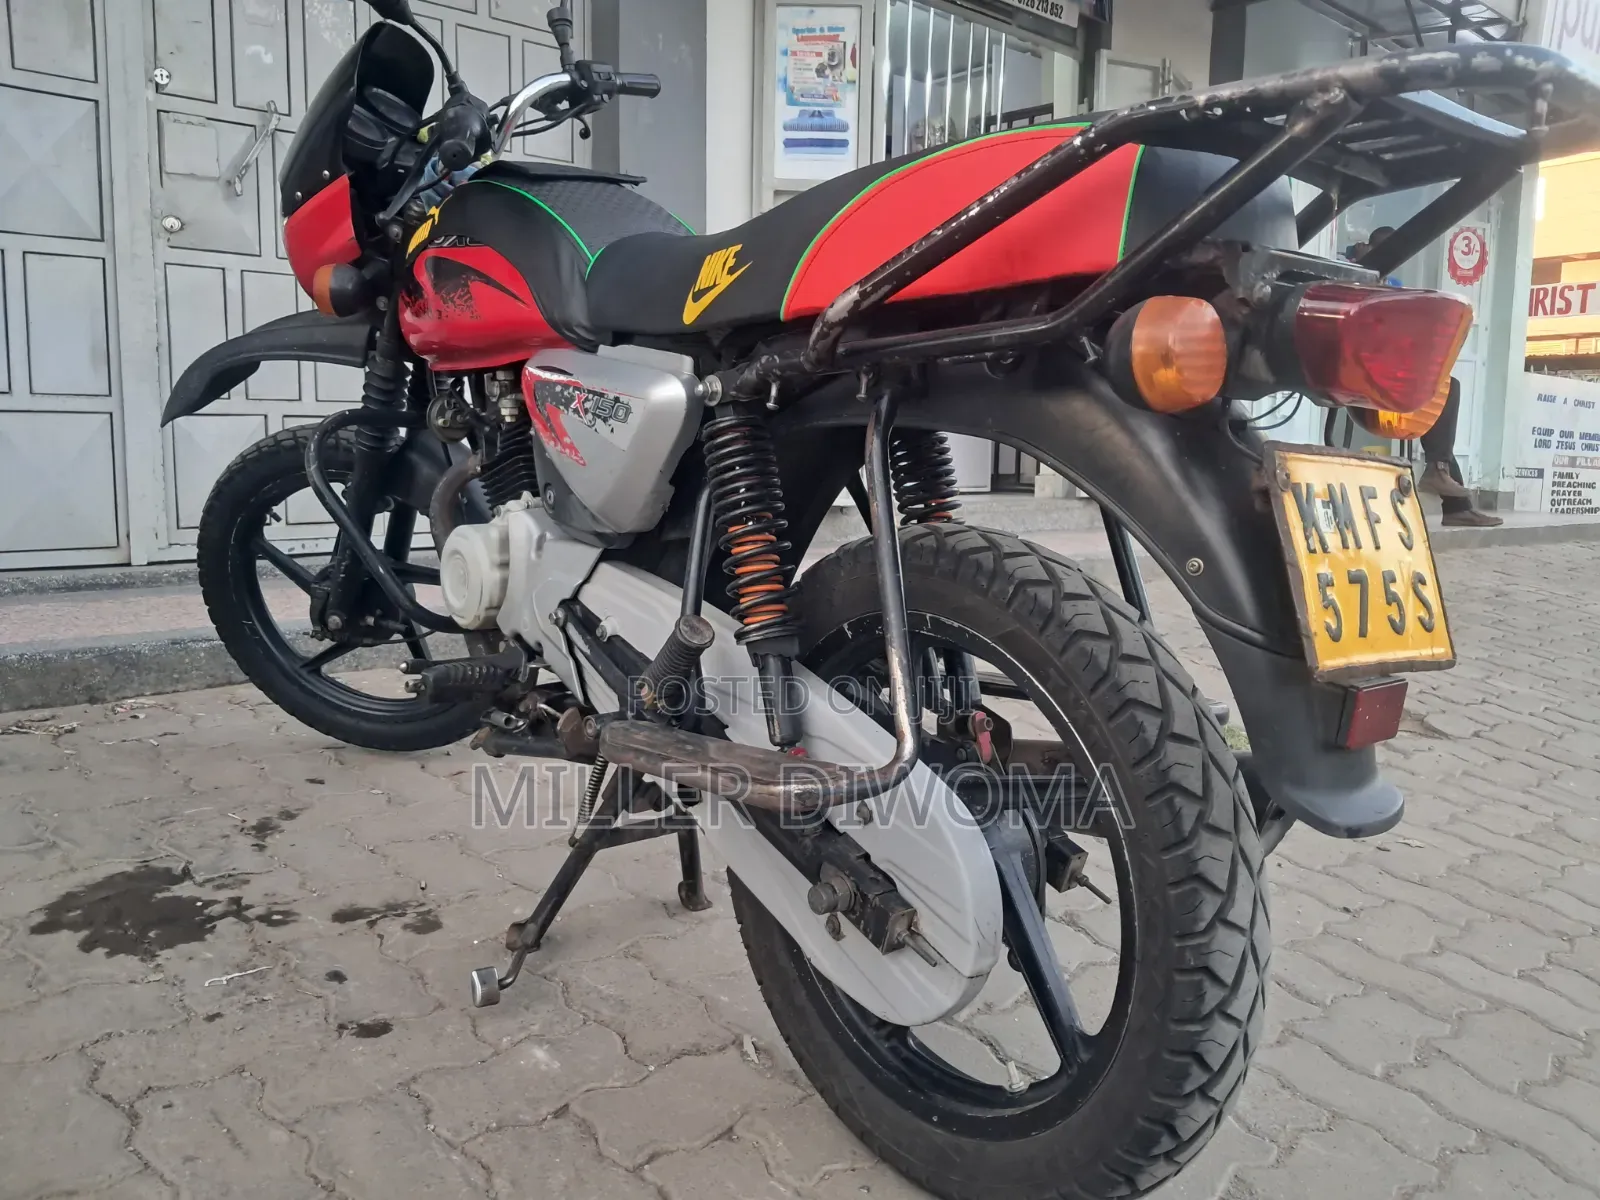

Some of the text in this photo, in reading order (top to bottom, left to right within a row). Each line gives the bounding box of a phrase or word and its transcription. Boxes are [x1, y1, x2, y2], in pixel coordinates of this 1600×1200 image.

[1049, 2, 1064, 19] 852
[1537, 393, 1595, 409] RAISE A CHRIST
[1532, 426, 1554, 438] EQUIP
[1559, 430, 1574, 440] OUR
[1534, 438, 1600, 452] LORD JESUS CHRIS
[1552, 471, 1580, 480] FAMILY
[1552, 480, 1596, 490] PREACHING
[1551, 489, 1582, 497] PRAYER
[1550, 498, 1592, 507] OUTREACH
[1316, 568, 1435, 643] 575S
